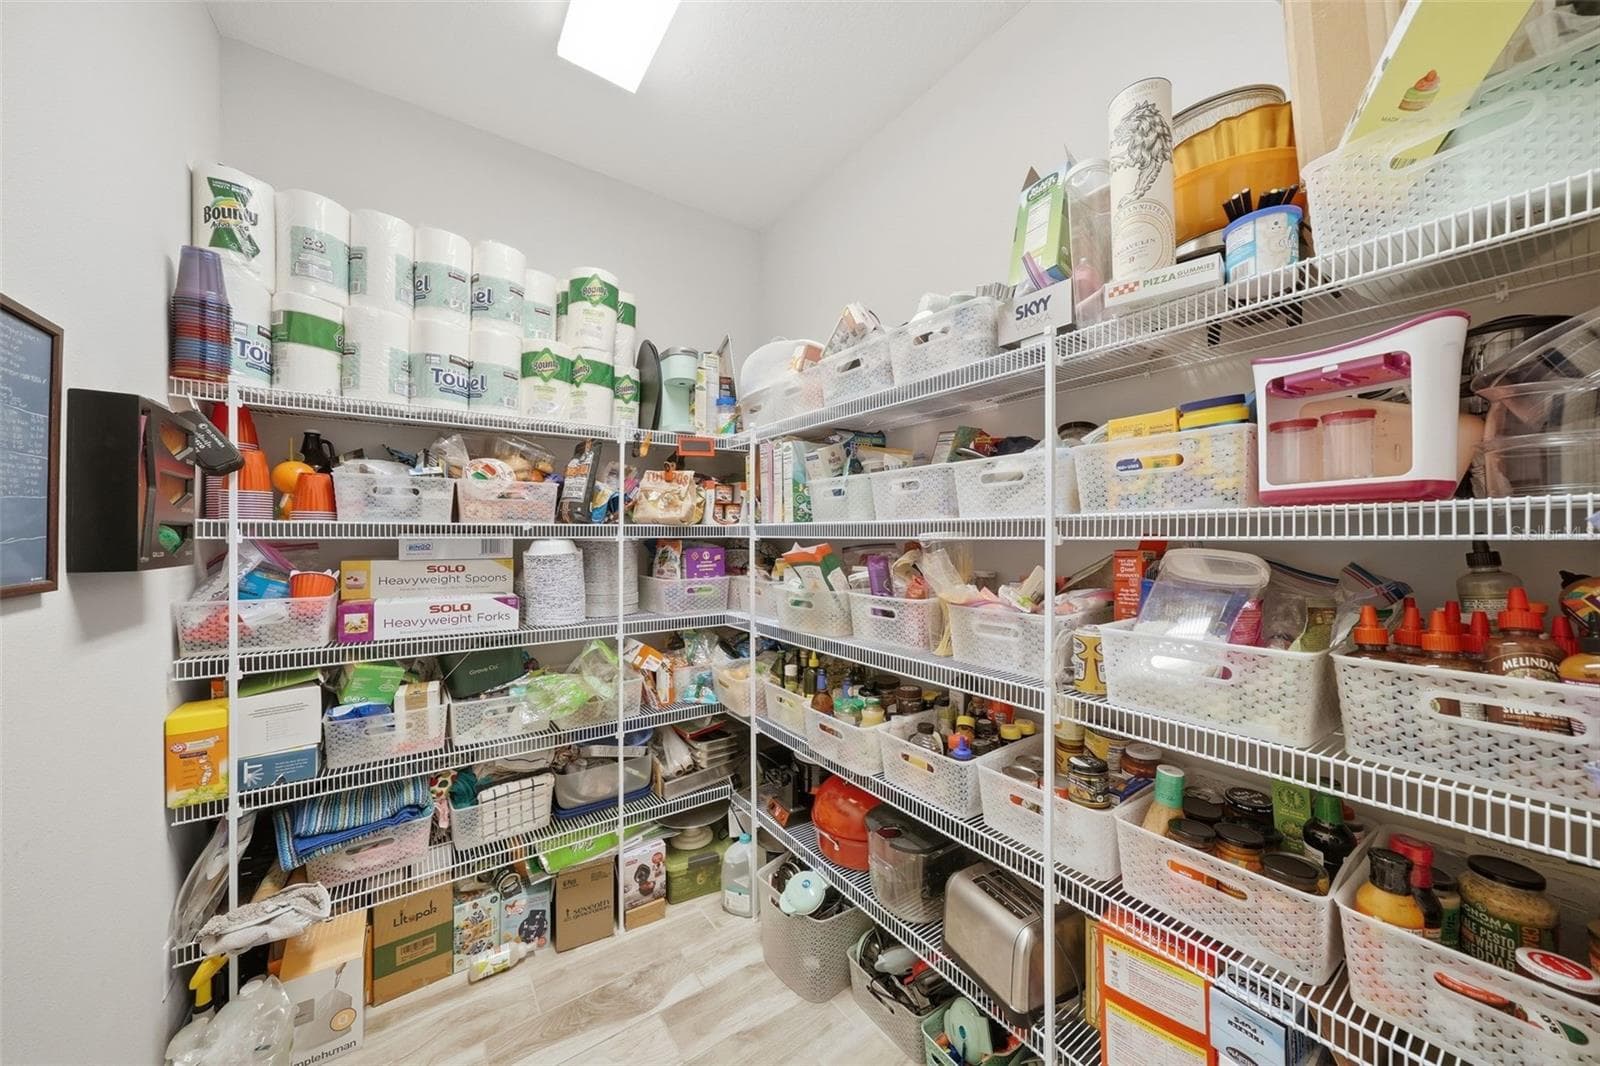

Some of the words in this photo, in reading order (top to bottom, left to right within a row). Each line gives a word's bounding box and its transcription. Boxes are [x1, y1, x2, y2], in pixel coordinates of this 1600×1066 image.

[203, 205, 258, 226] Bounty
[1143, 273, 1177, 288] PIZZA
[1177, 262, 1216, 277] GUMMIES
[1016, 295, 1052, 321] SKYY
[378, 574, 460, 587] Heavyweight
[465, 573, 508, 584] Spoons
[426, 564, 466, 574] SOLO
[429, 602, 472, 614] SOLO
[383, 615, 473, 628] Heavyweight
[477, 611, 511, 623] Forks
[1475, 935, 1516, 961] WHITE
[1480, 926, 1516, 950] PESTO
[294, 1040, 357, 1066] mplehuman
